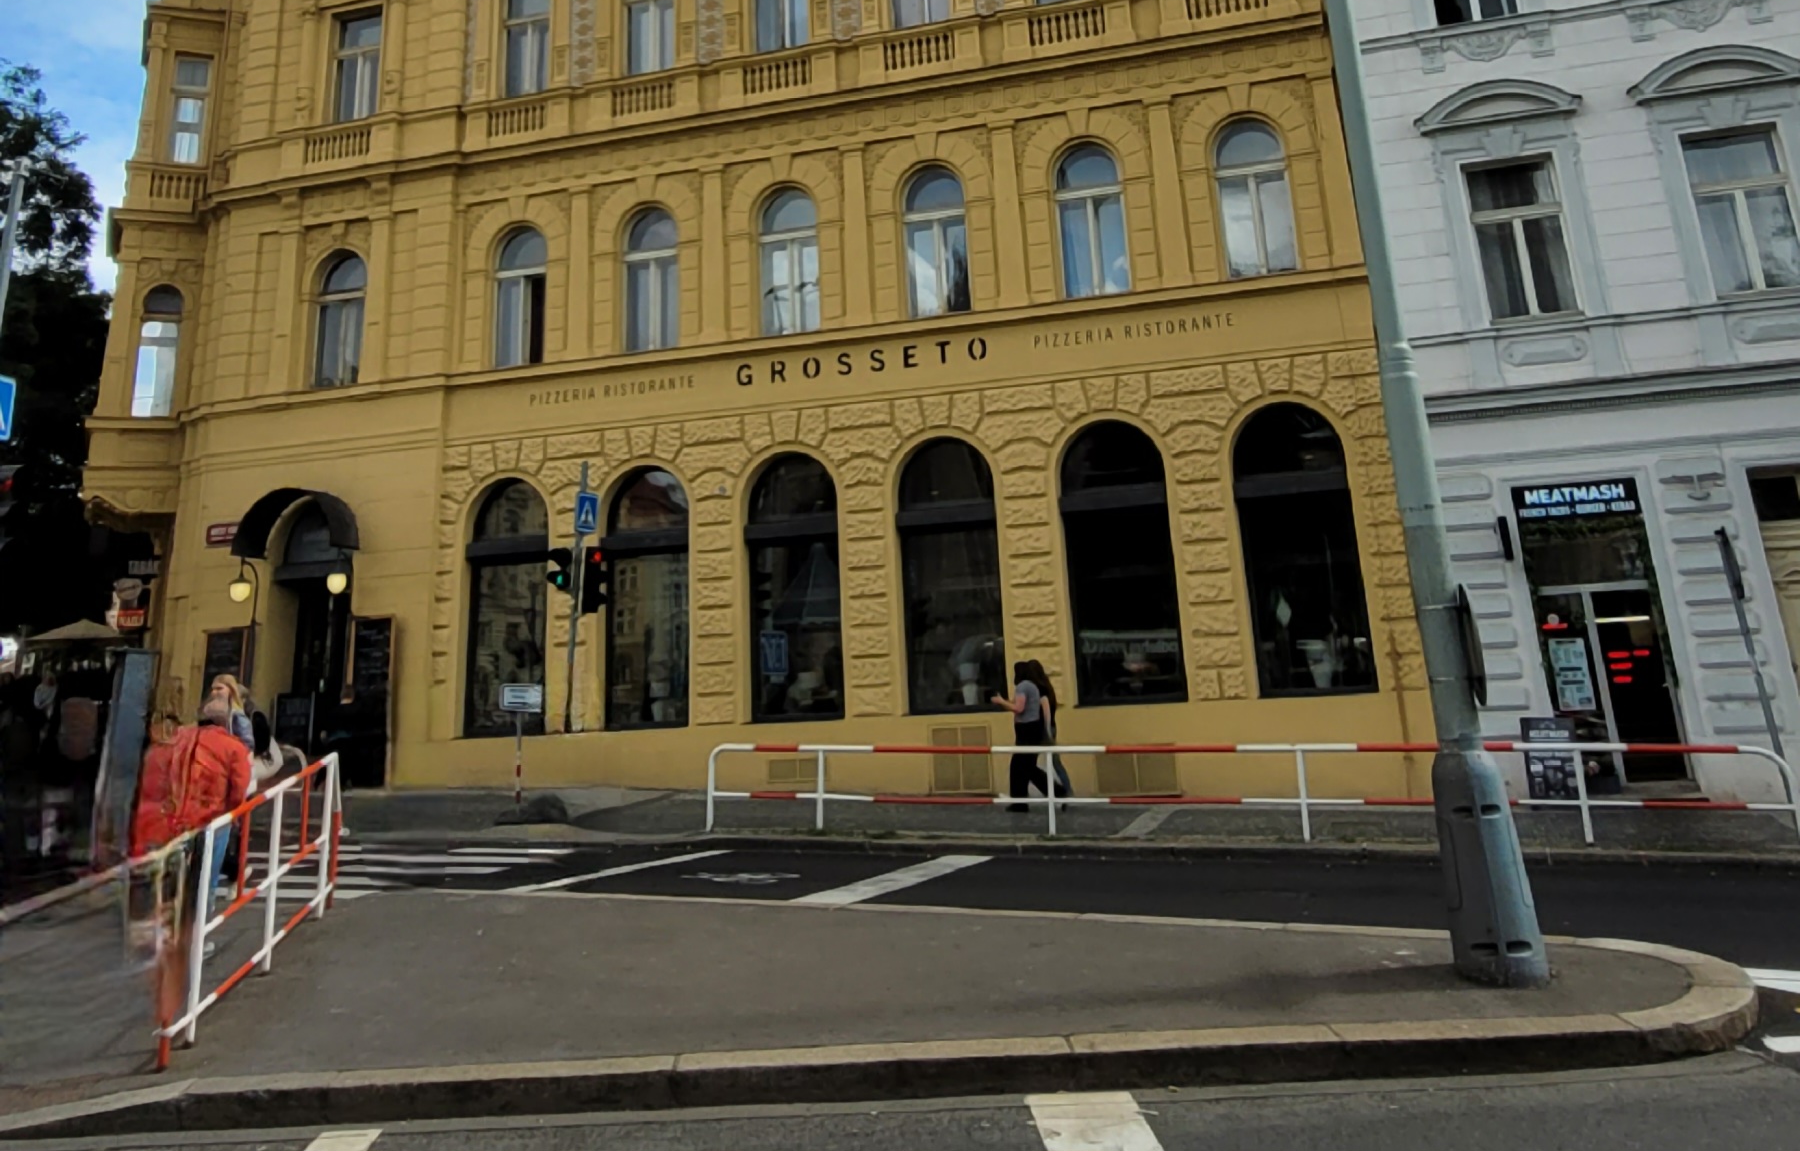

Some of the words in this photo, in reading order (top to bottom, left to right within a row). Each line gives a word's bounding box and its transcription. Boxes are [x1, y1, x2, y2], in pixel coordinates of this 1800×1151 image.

[1033, 327, 1114, 349] PIZZERIA
[1124, 312, 1235, 340] RISTORANTE
[736, 337, 988, 386] GROSSETO
[529, 386, 596, 407] PIZZERIA
[603, 374, 695, 398] RISTORANTE
[1523, 483, 1625, 505] MEATMASH
